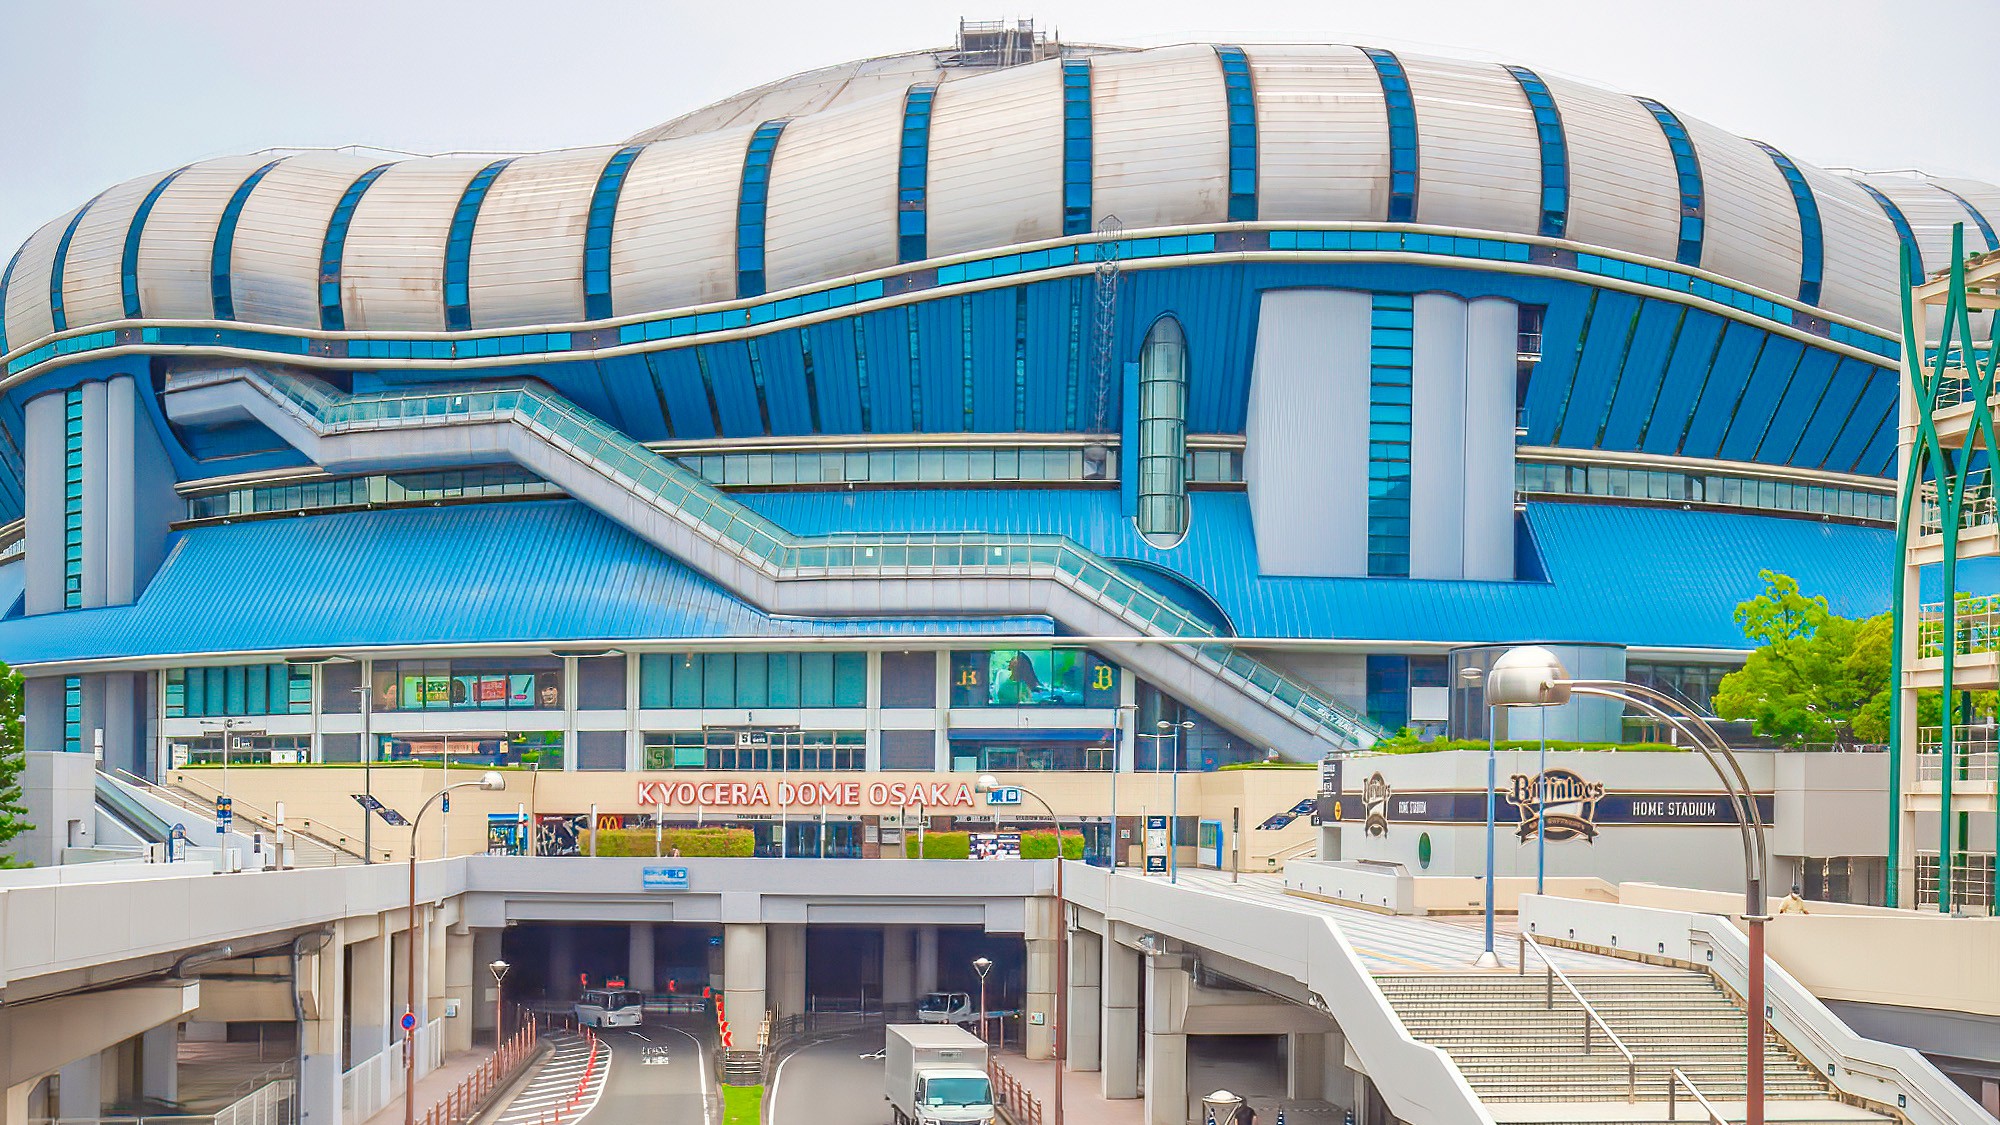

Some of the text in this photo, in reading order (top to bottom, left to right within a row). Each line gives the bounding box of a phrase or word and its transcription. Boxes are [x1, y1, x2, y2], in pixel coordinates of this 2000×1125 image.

[637, 781, 975, 807] KYOCERA DOME OSAKA
[1632, 801, 1716, 817] HOME STADIUM
